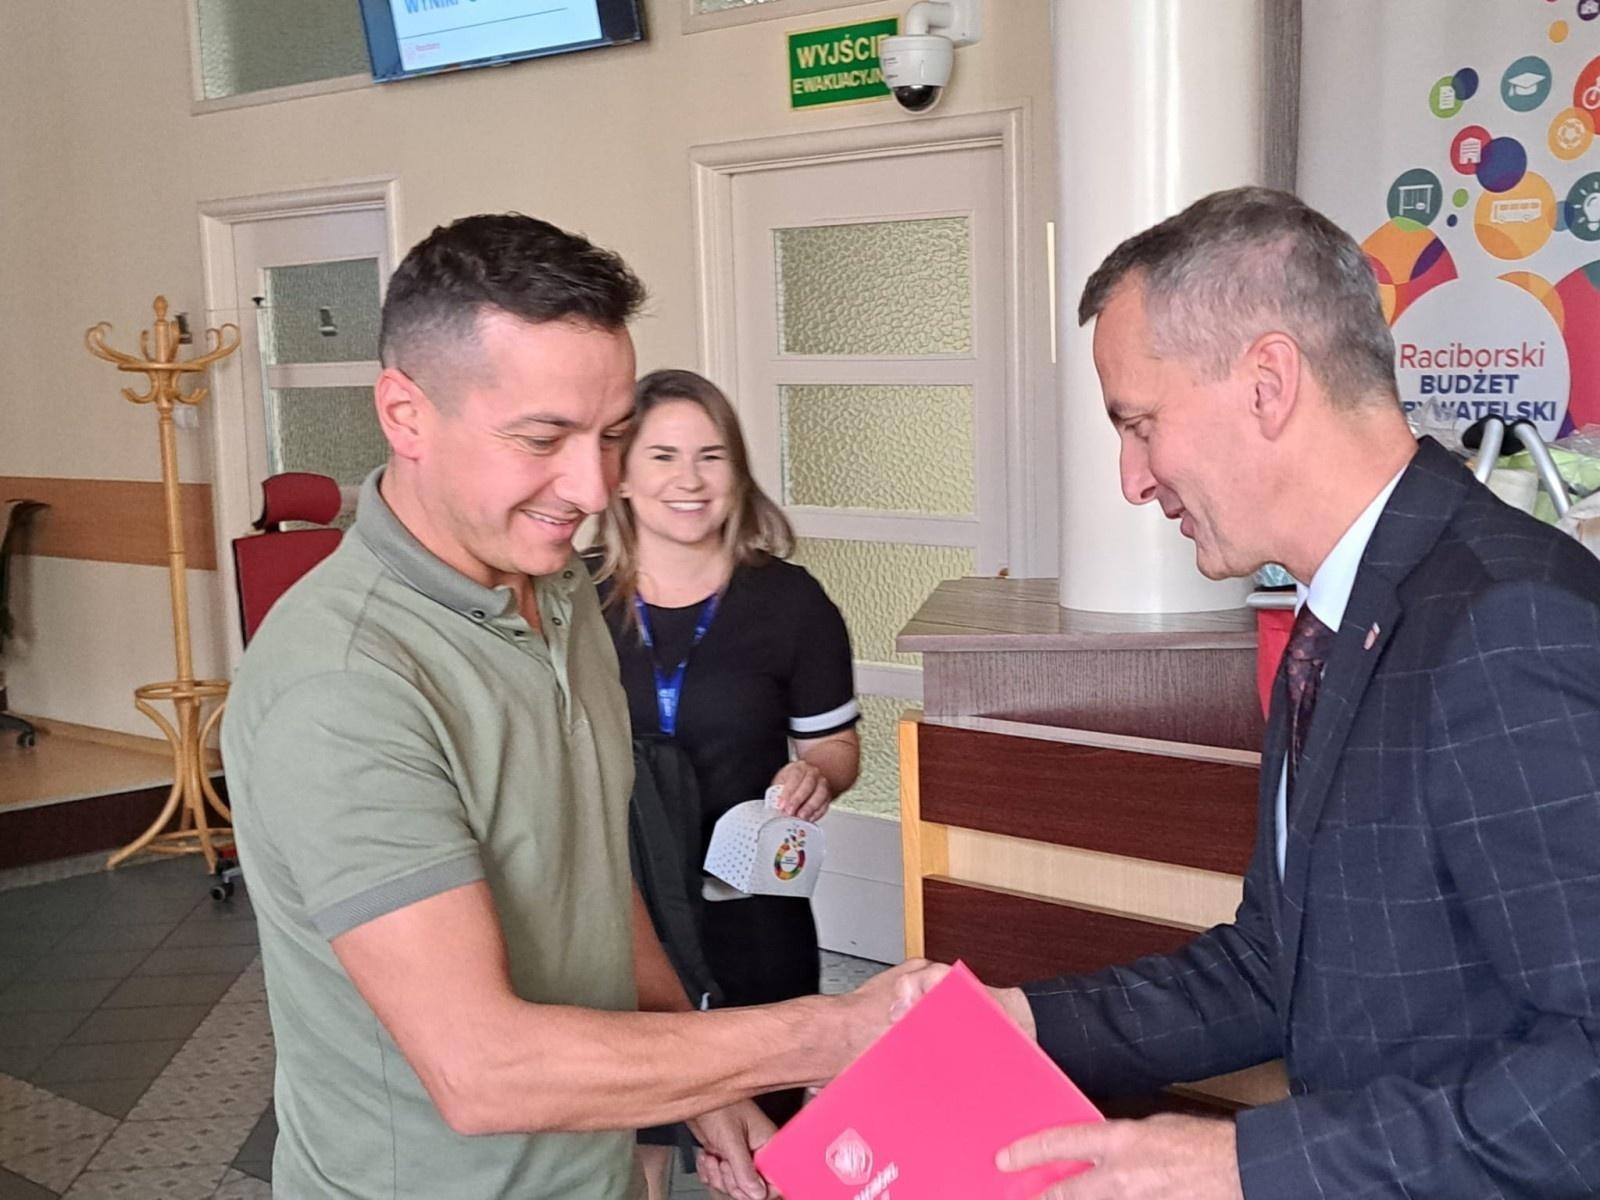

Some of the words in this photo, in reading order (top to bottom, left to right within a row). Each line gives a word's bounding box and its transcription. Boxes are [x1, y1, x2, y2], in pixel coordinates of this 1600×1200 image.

[793, 67, 884, 94] EWAKUACYJN
[1401, 341, 1545, 368] Raciborski
[1420, 369, 1519, 395] BUDŻET
